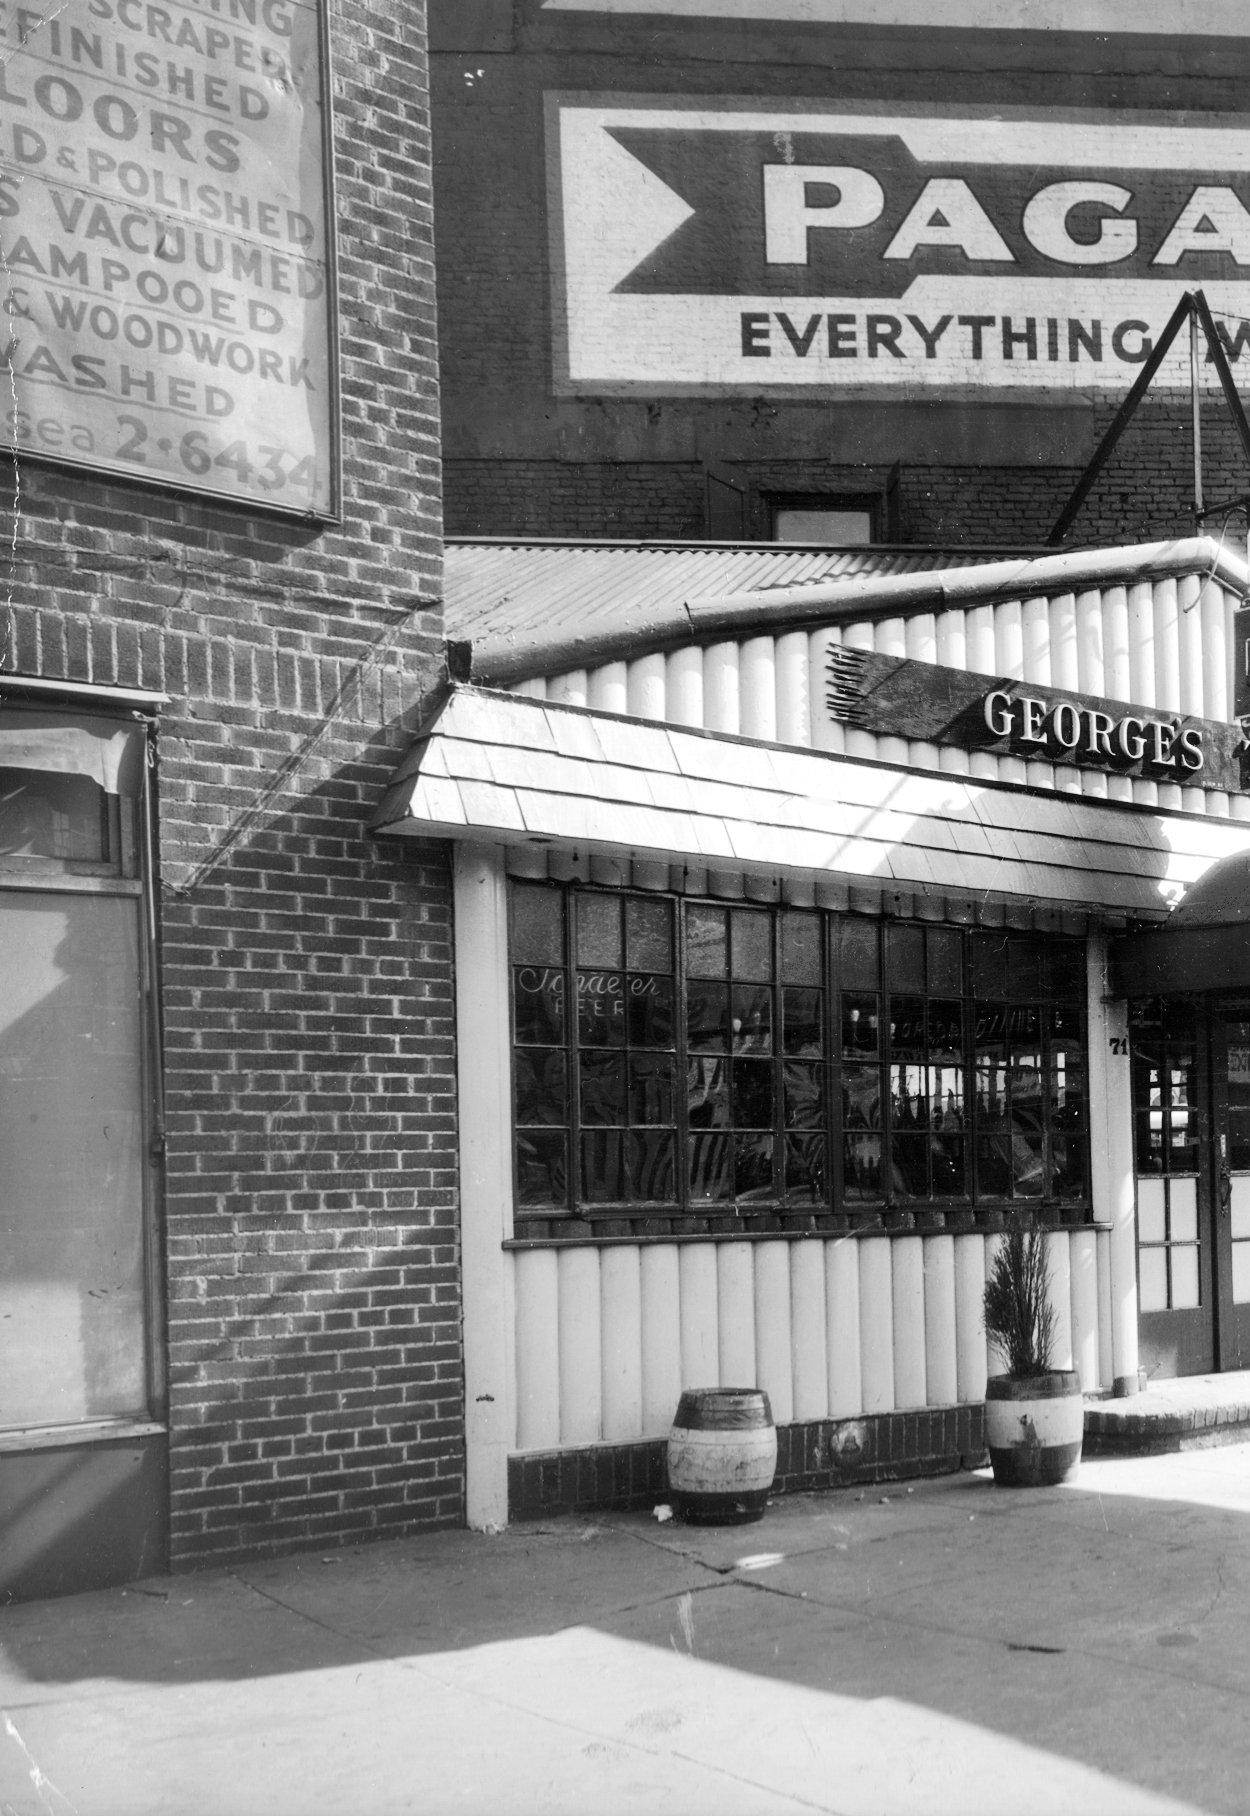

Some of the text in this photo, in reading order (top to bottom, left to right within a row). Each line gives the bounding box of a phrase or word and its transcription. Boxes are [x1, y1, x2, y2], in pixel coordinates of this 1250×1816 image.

[0, 2, 270, 121] FINISHED
[49, 188, 323, 301] VACUUMED
[56, 146, 80, 174] &
[87, 147, 315, 248] POLISHED
[45, 290, 316, 391] WOODWORK
[740, 311, 1154, 364] EVERYTHING
[984, 690, 1204, 771] GEORGE'S
[1108, 1036, 1129, 1056] 71
